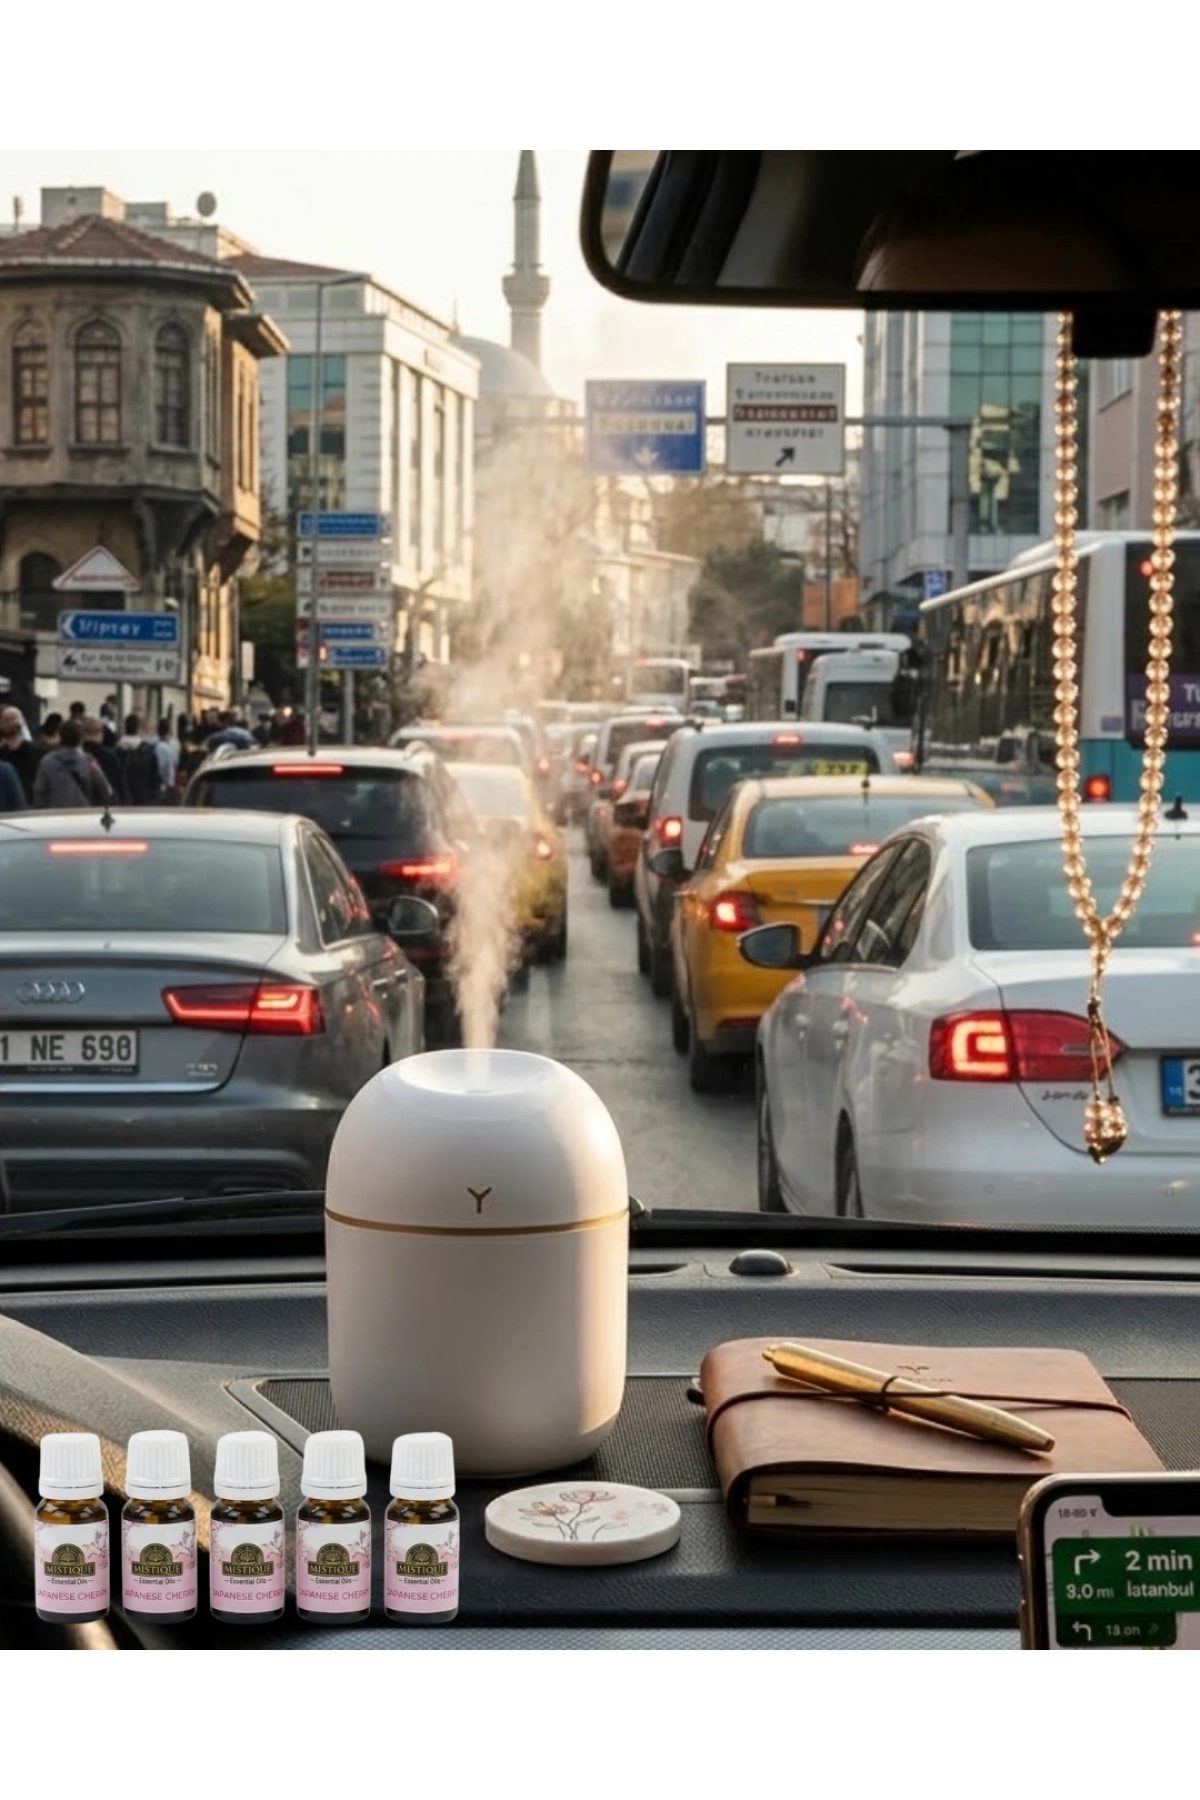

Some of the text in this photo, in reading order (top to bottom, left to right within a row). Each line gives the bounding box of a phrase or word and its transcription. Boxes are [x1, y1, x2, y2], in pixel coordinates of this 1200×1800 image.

[31, 1034, 65, 1061] NE
[1125, 1549, 1193, 1571] 2 min
[46, 1565, 93, 1576] MISTIQUE
[133, 1565, 181, 1576] MISTIQUE
[225, 1565, 272, 1575] MISTIQUE
[309, 1564, 357, 1575] MISTIQUE
[398, 1564, 446, 1575] MISTIQUE
[315, 1577, 340, 1585] Essential
[404, 1577, 429, 1585] Essential
[1066, 1583, 1093, 1599] 3.0
